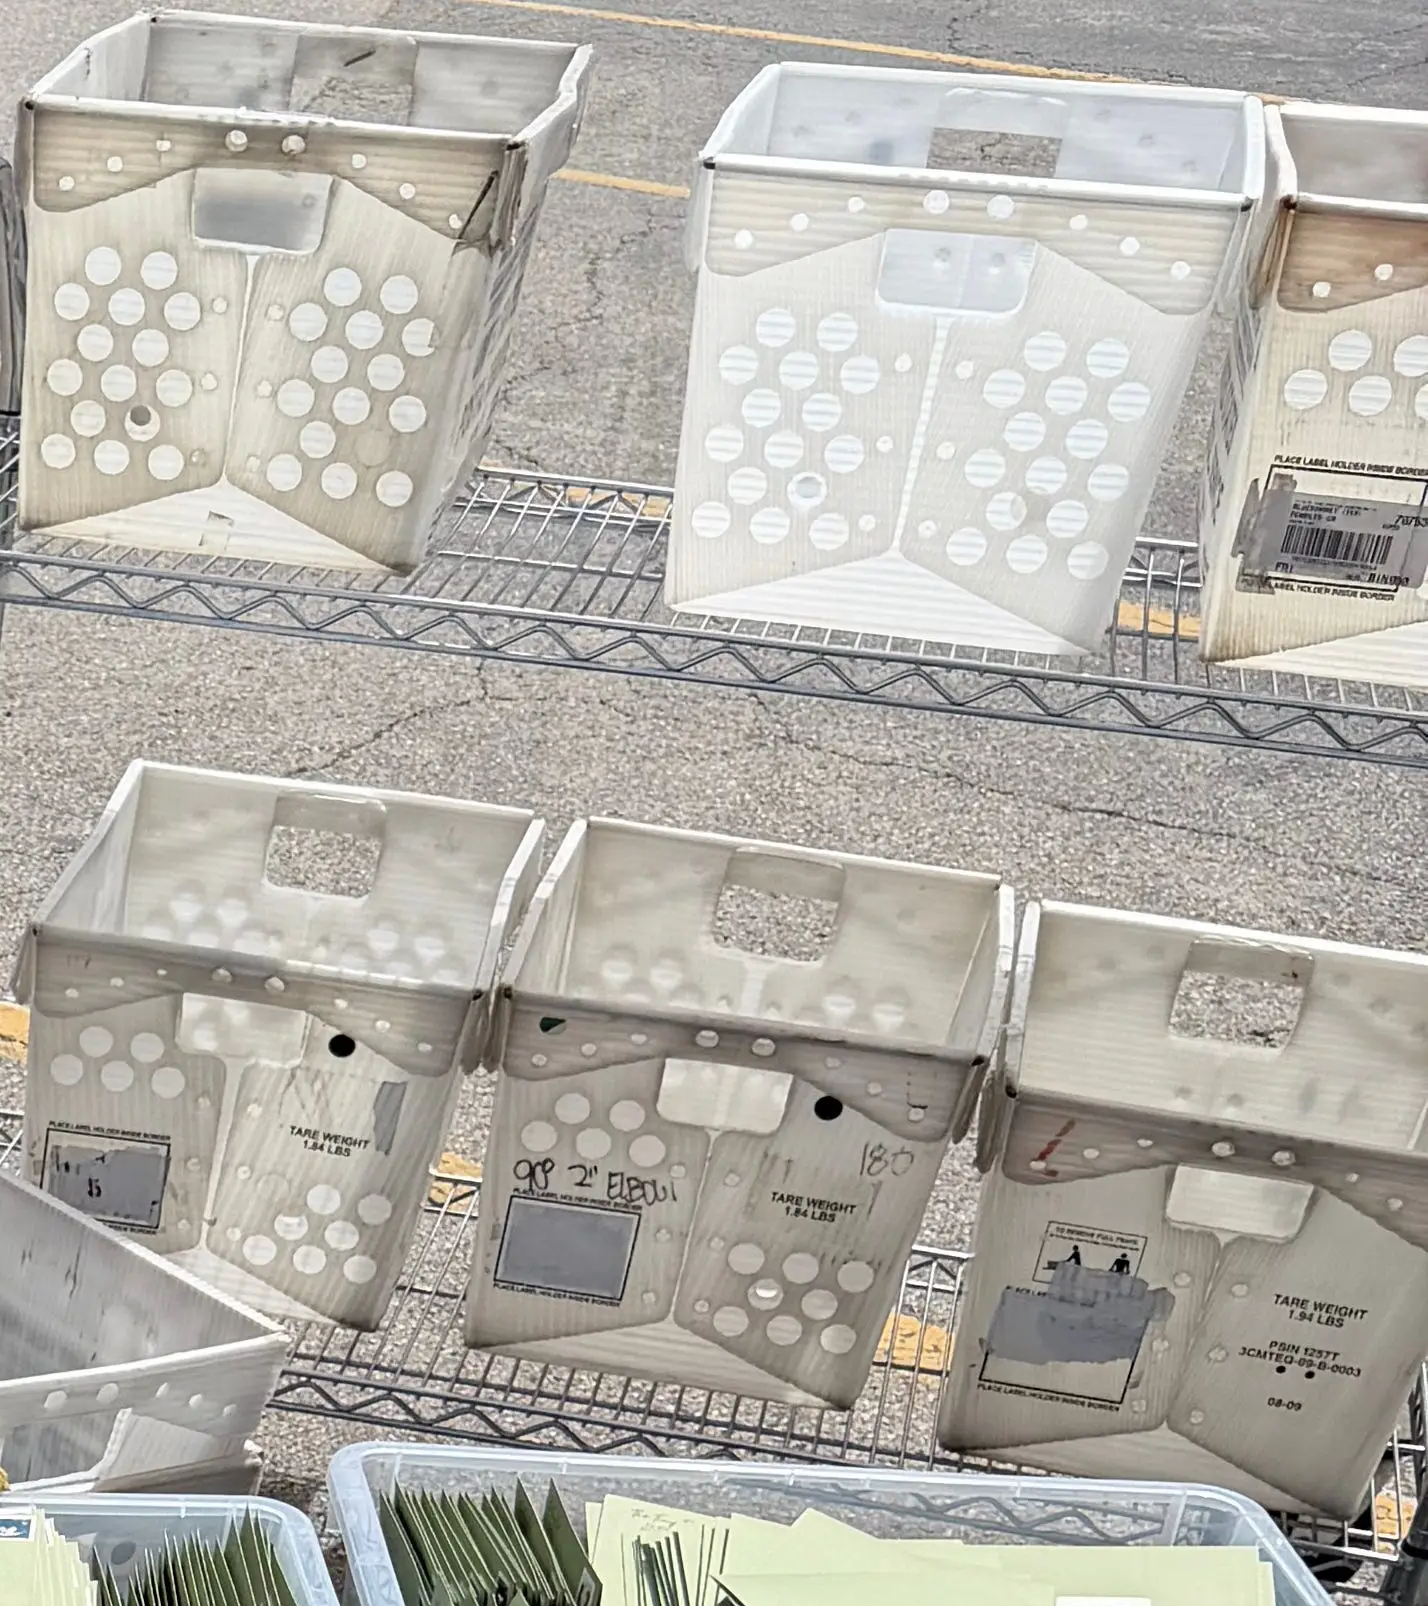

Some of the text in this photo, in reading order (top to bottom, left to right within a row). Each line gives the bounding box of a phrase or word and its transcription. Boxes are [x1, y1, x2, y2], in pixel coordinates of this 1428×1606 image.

[290, 1125, 370, 1150] TARE WEIGHT
[327, 1145, 351, 1157] LBS
[771, 1191, 857, 1215] TARE WEIGHT
[811, 1209, 836, 1223] LBS
[1274, 1294, 1368, 1320] TARE WEIGHT
[1316, 1314, 1344, 1328] LBS
